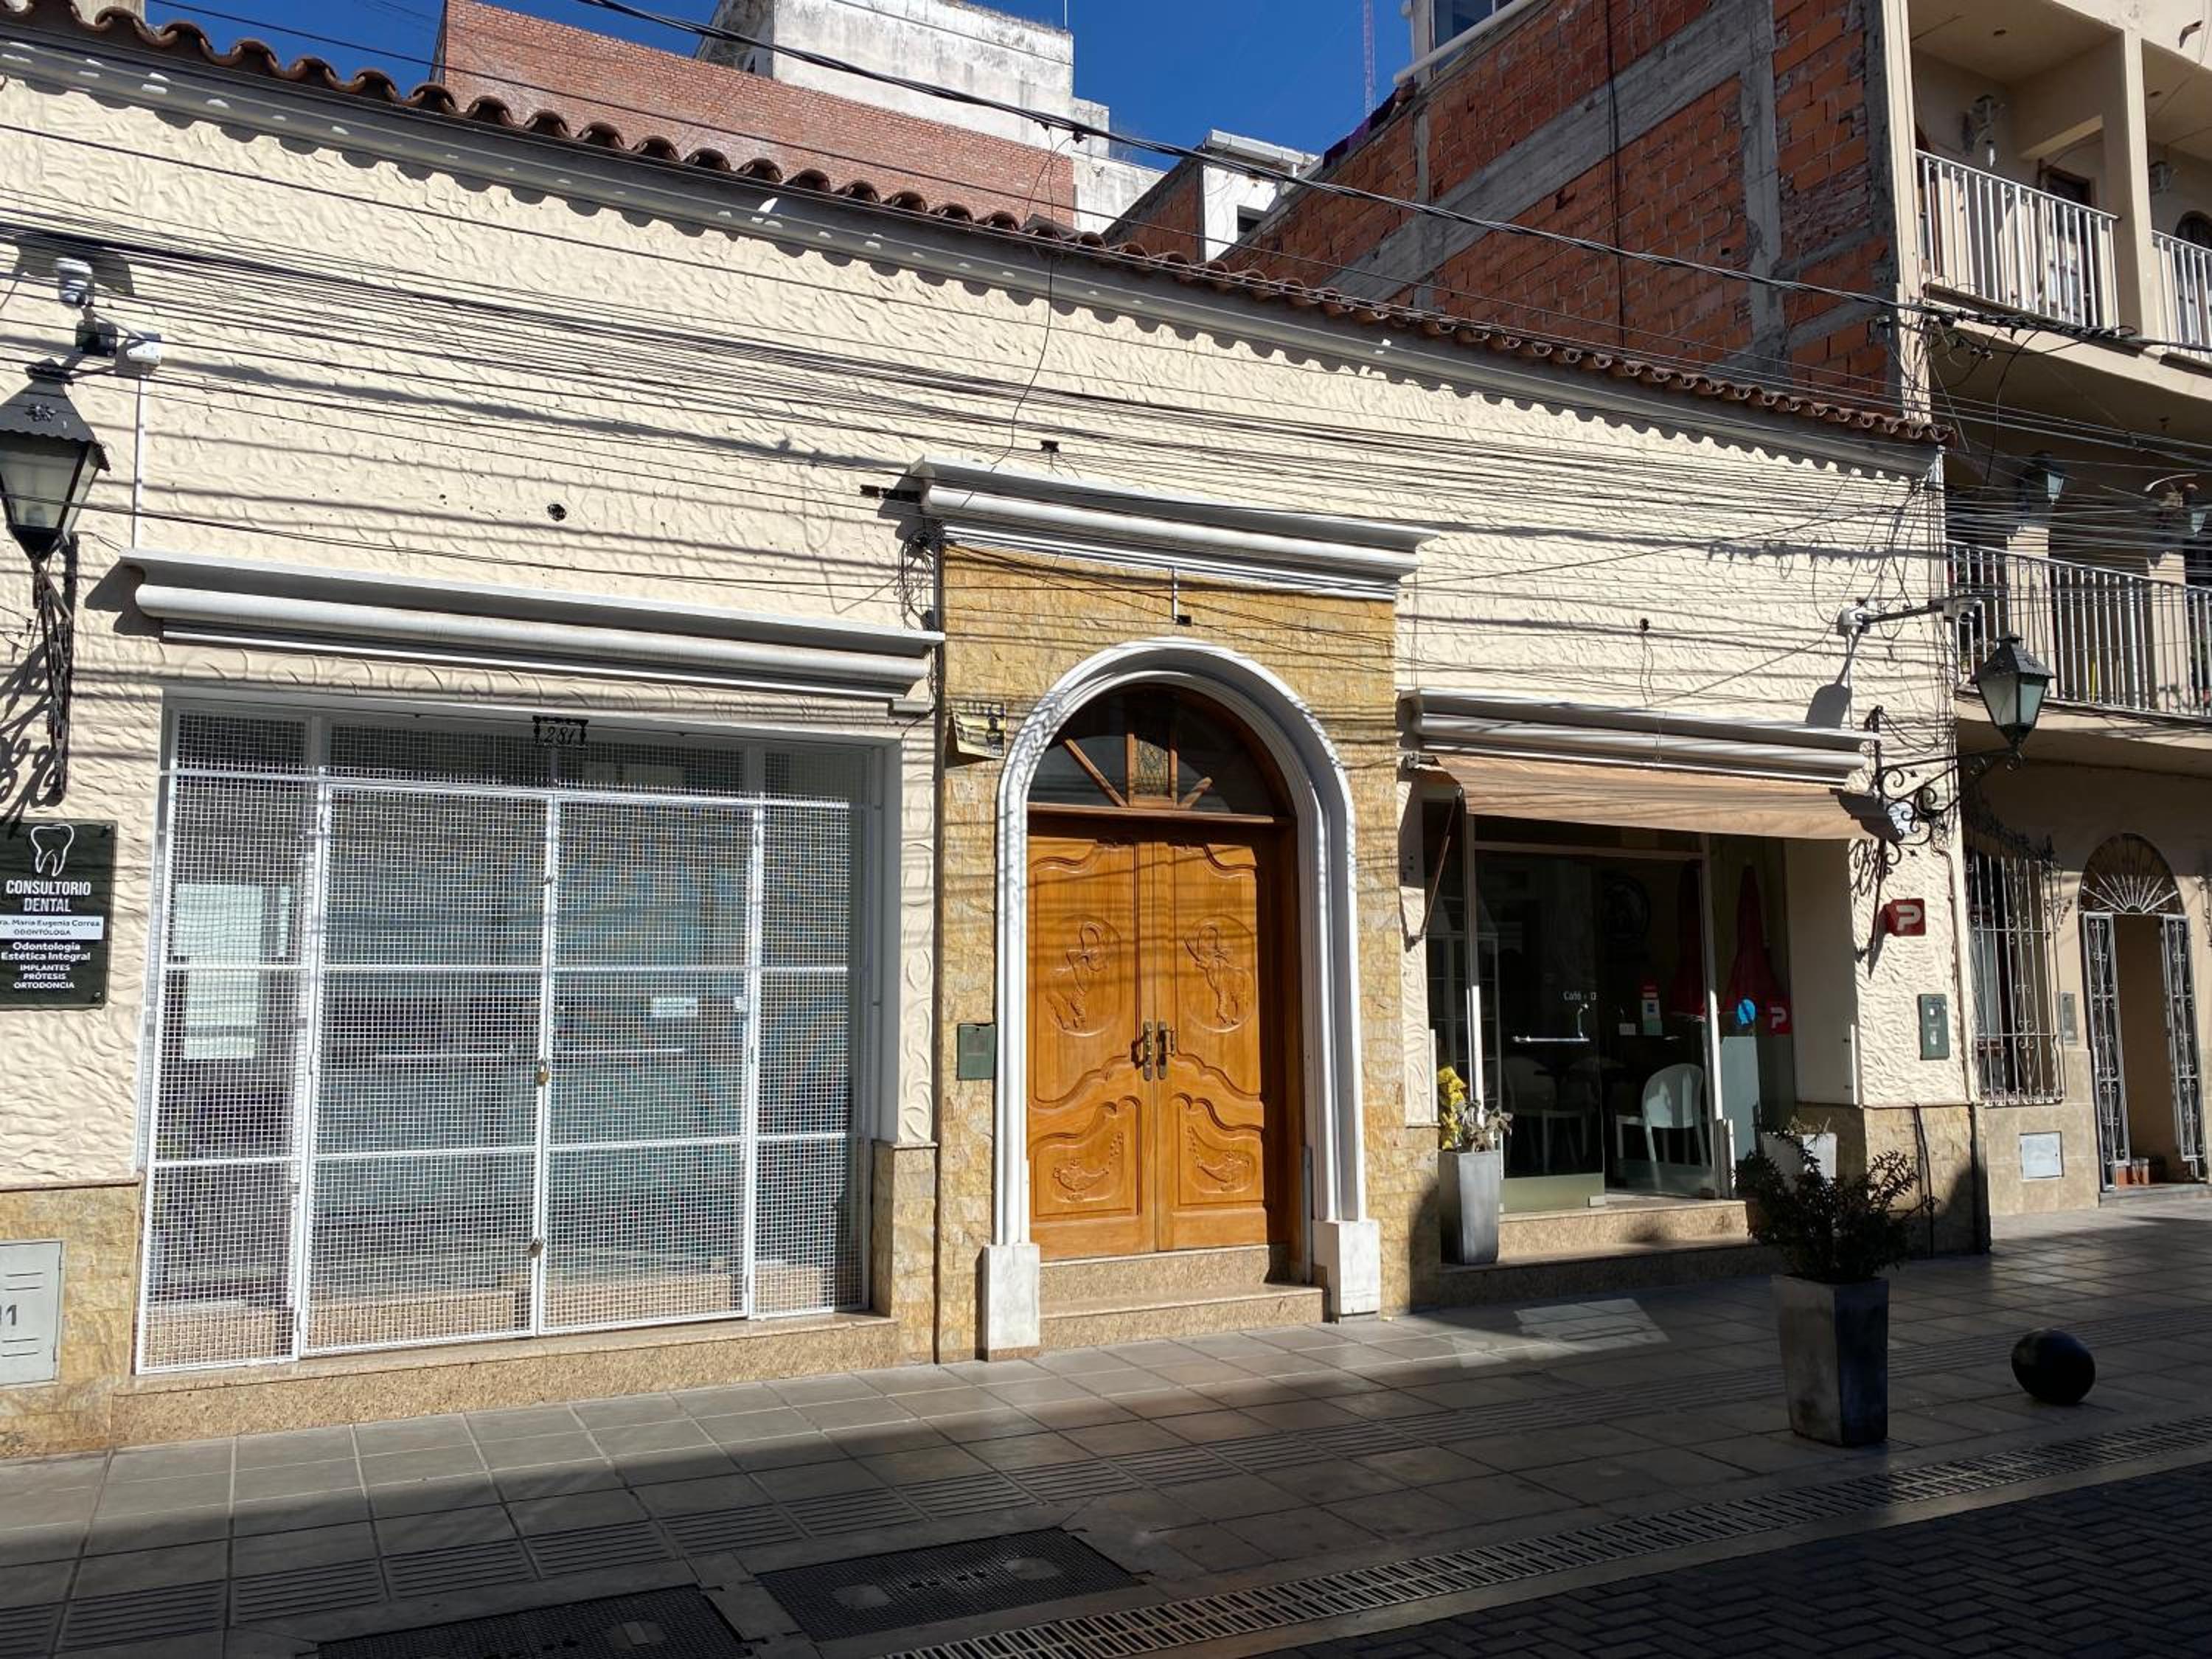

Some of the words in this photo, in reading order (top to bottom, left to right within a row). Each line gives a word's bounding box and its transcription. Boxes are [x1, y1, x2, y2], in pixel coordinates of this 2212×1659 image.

[6, 880, 91, 896] CONSULTORIO
[24, 897, 72, 912] DENTAL
[1, 952, 46, 960] Estética
[48, 952, 91, 961] Integral
[23, 971, 66, 979] PRÓTESIS
